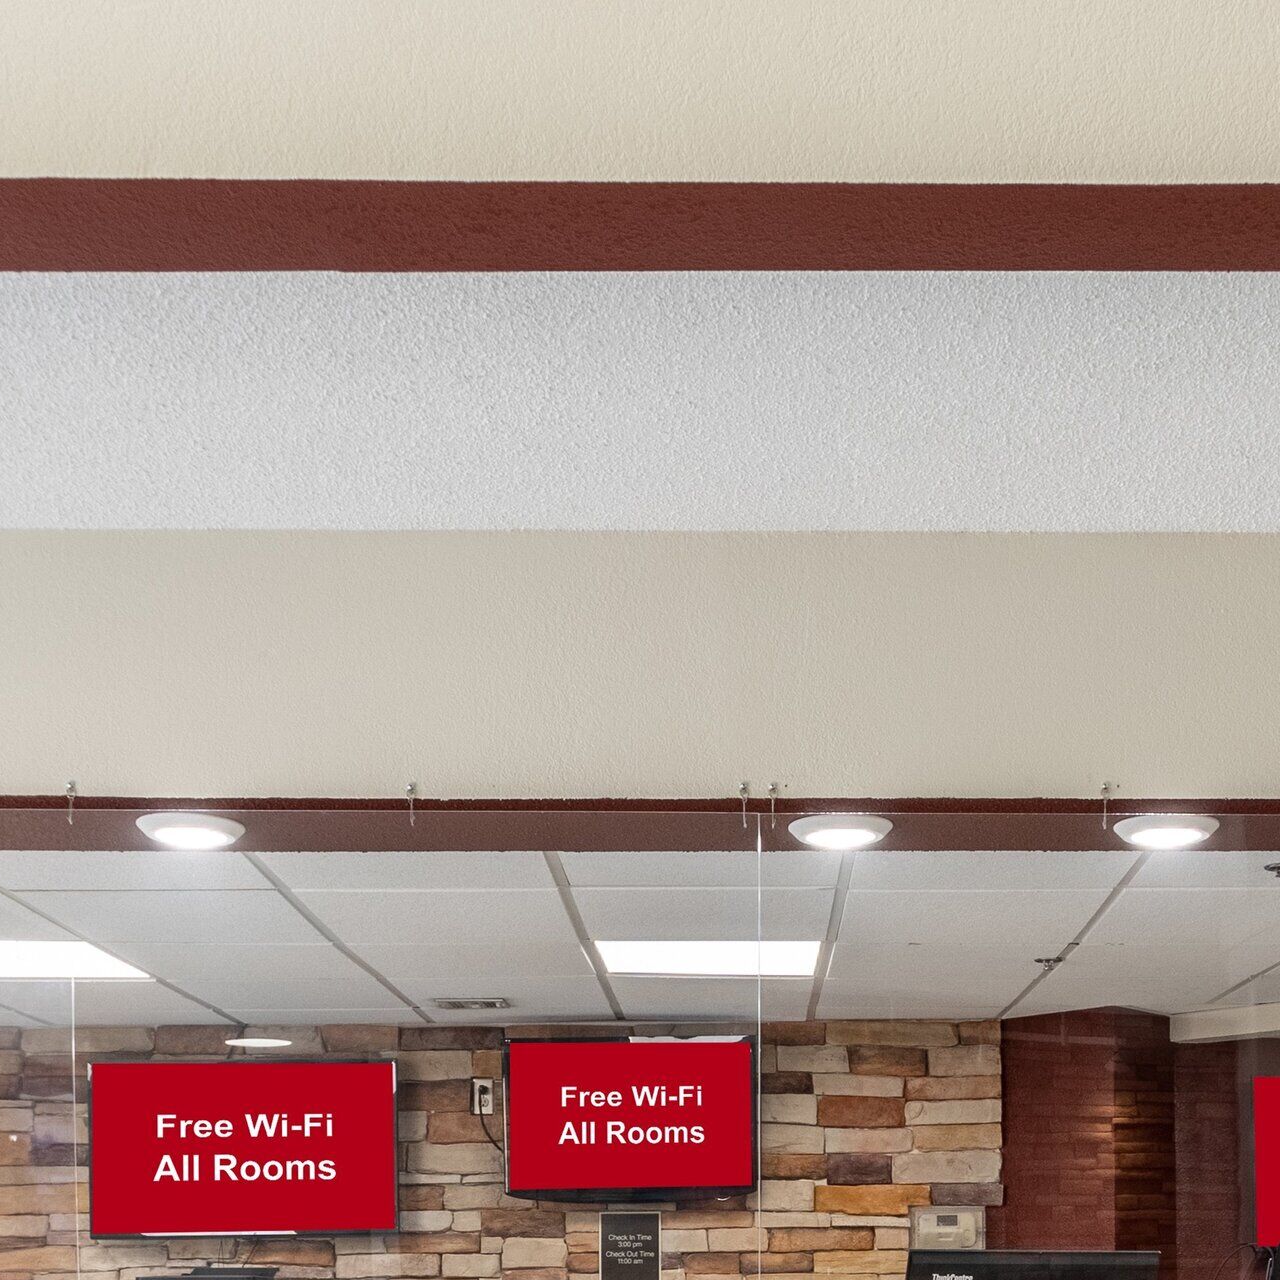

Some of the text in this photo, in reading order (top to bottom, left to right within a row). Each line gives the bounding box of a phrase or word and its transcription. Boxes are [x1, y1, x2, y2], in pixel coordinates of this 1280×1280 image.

[561, 1085, 703, 1108] Free Wi-Fi
[156, 1113, 334, 1139] Free Wi-Fi
[558, 1120, 705, 1145] All Rooms
[153, 1153, 337, 1182] All Rooms
